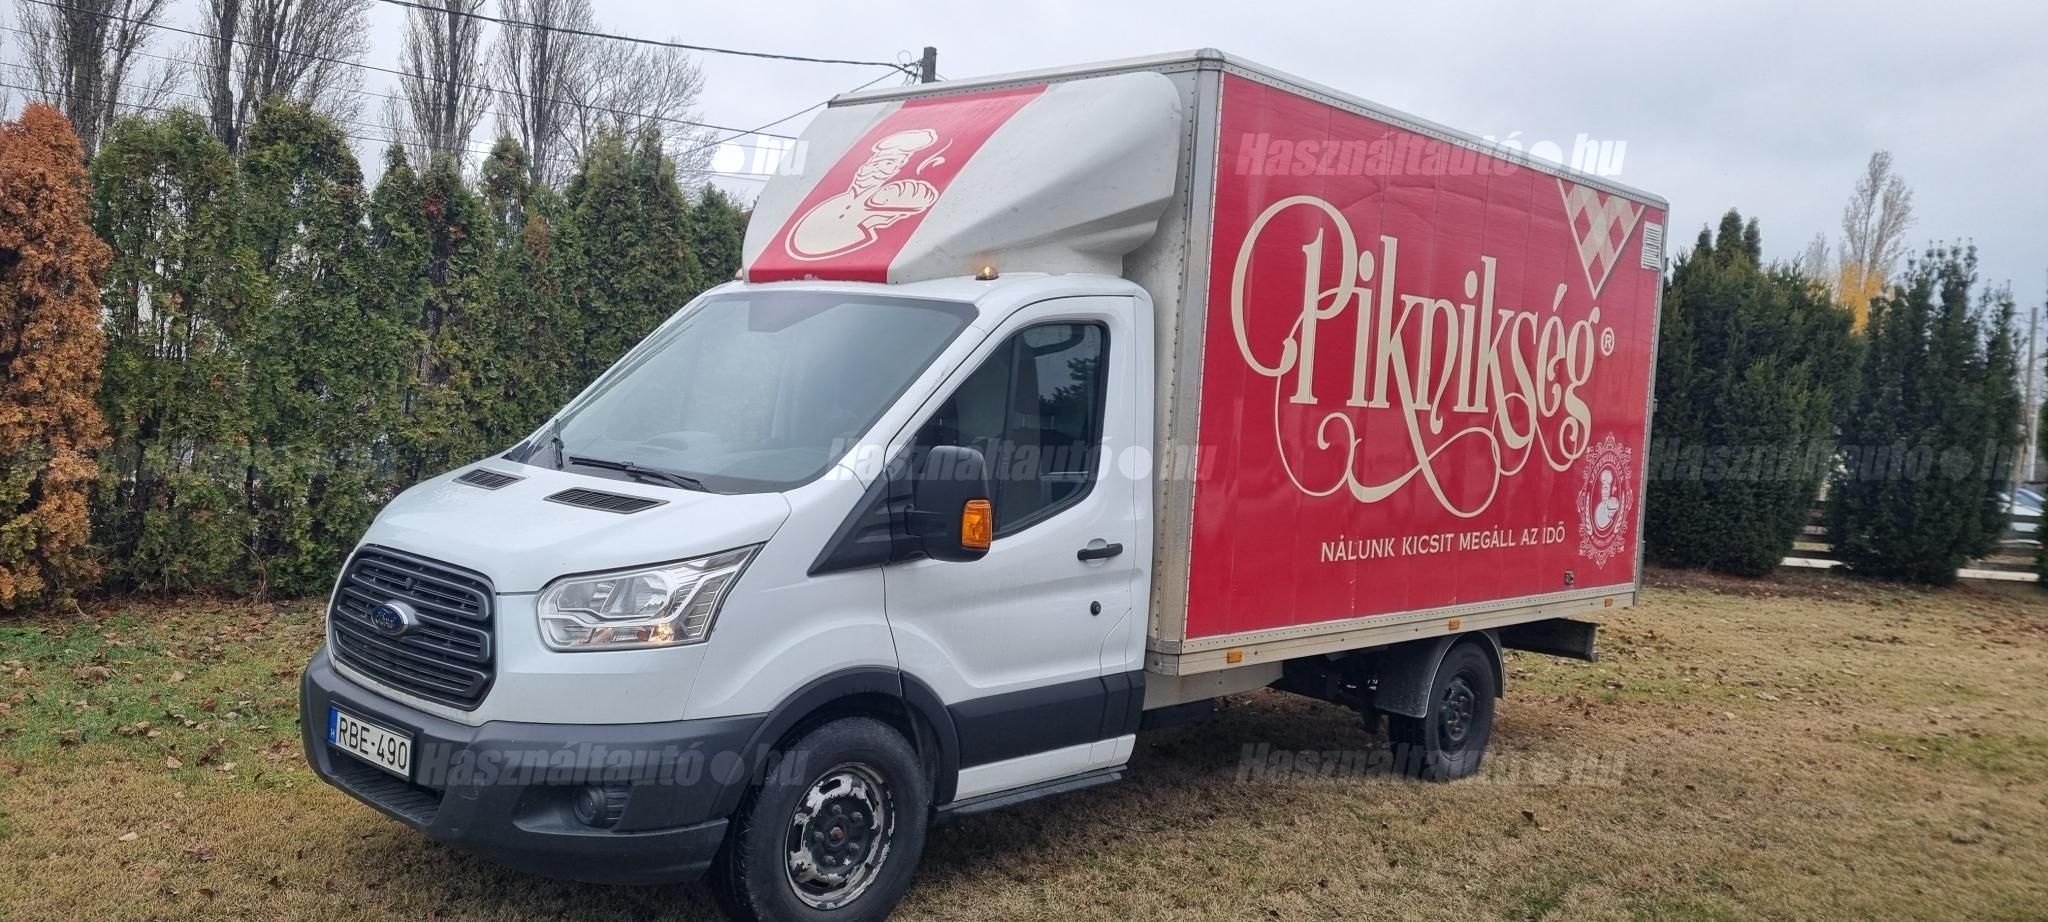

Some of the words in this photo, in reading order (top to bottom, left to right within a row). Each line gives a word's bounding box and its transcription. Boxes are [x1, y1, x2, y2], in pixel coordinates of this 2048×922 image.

[1231, 195, 1600, 518] Piknikség
[1320, 534, 1396, 563] NÁLUNK
[1402, 533, 1454, 556] KICSIT
[1459, 524, 1516, 551] MEGÁLL
[1520, 527, 1539, 546] AZ
[1542, 521, 1566, 545] IDŐ
[339, 716, 408, 769] RBE-490
